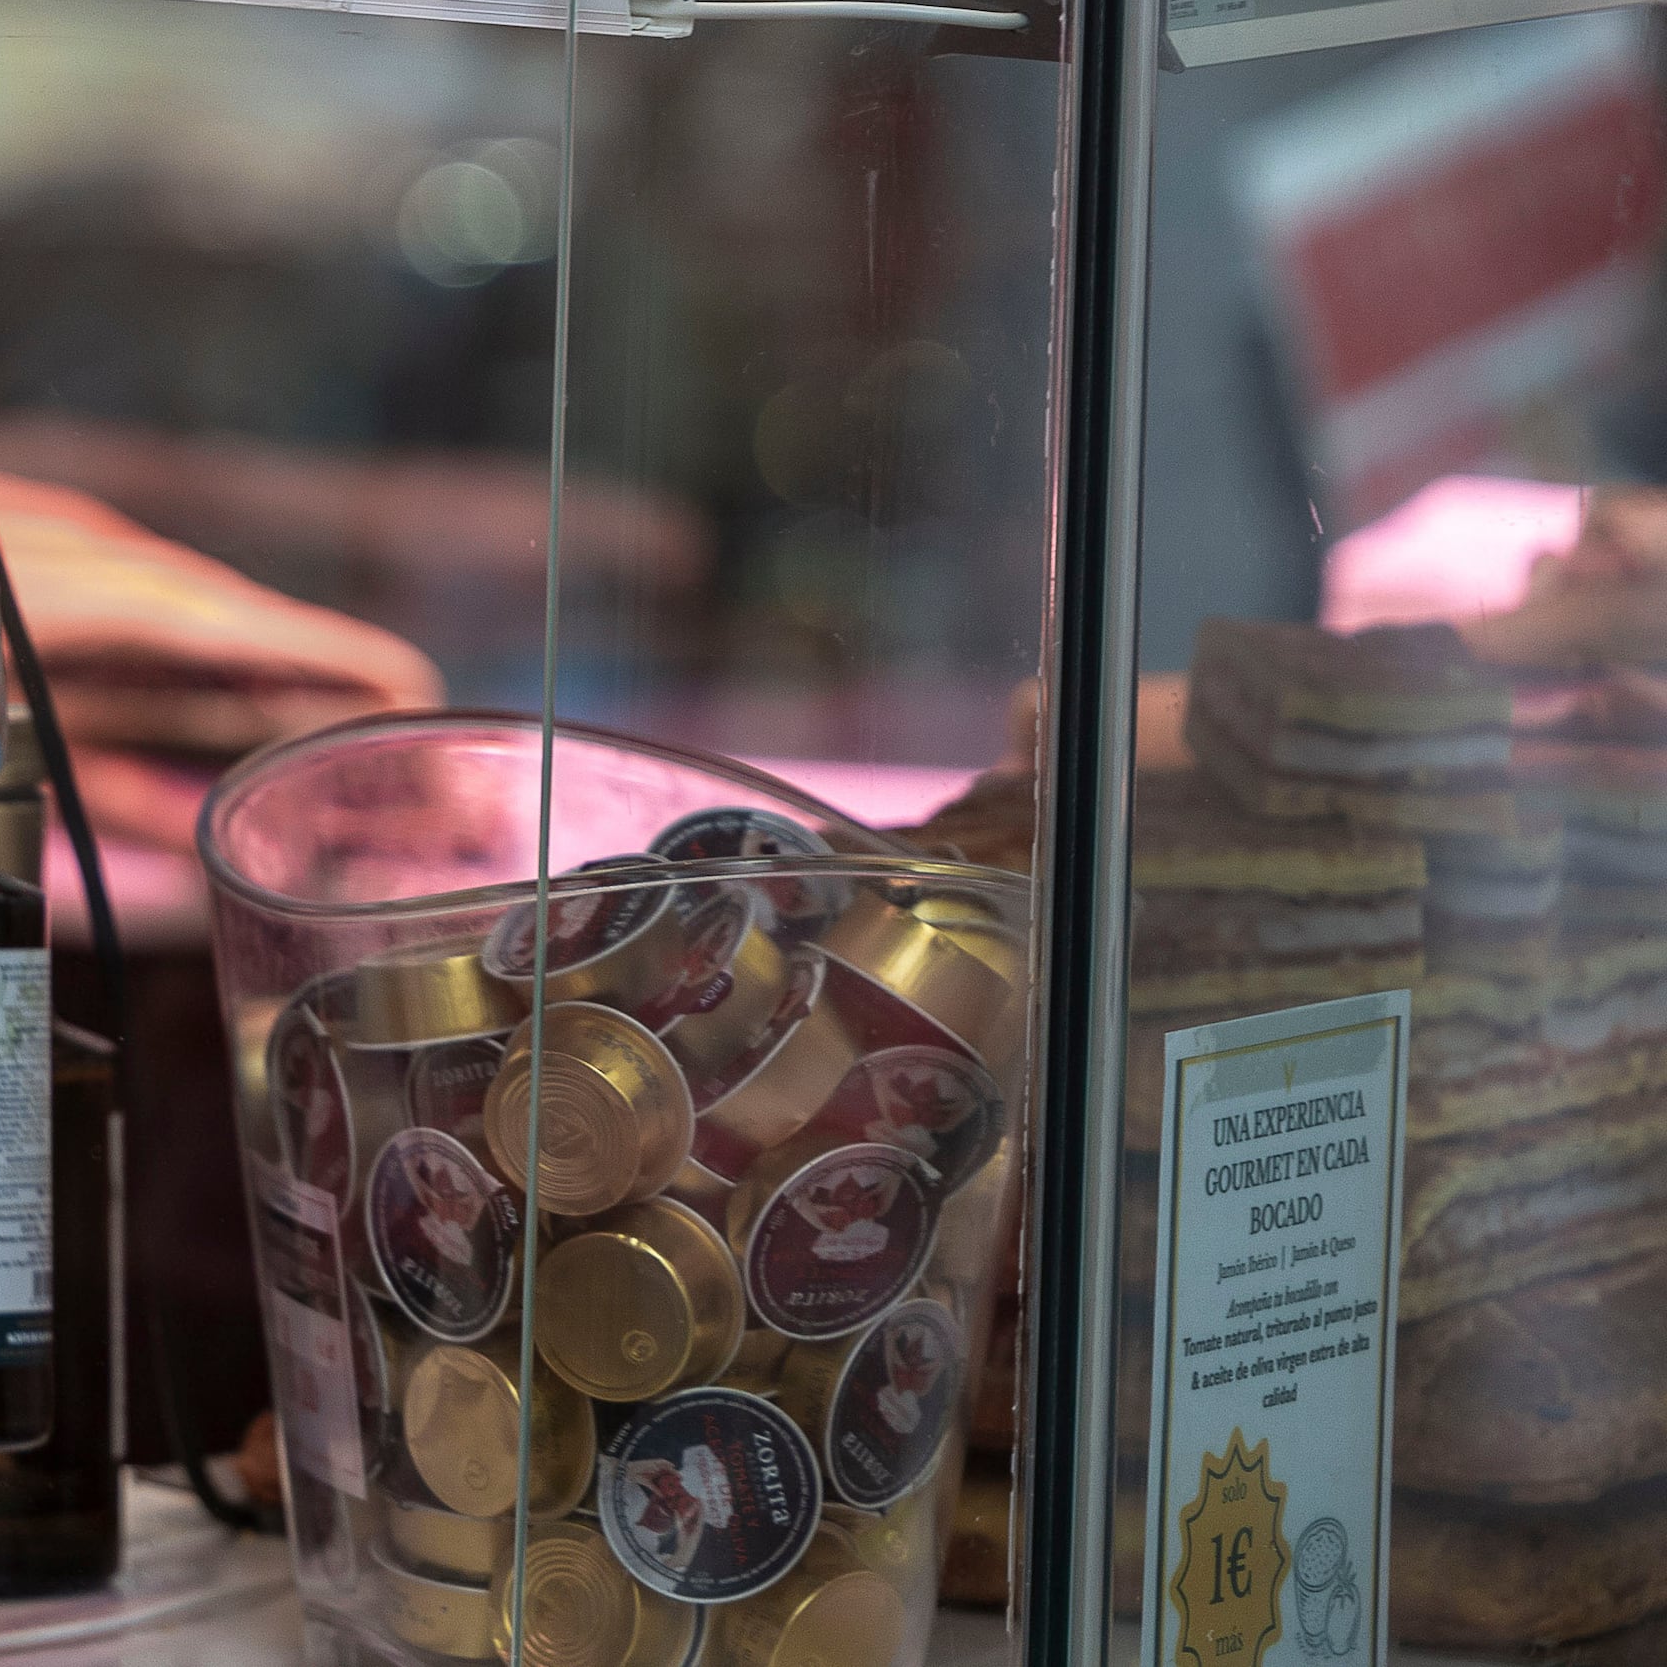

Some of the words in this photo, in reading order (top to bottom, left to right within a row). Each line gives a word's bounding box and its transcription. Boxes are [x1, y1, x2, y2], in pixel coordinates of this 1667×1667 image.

[1213, 1112, 1251, 1147] UNA
[1254, 1089, 1366, 1139] EXPERIENCIA
[1205, 1150, 1295, 1196] GOURMET
[1297, 1145, 1322, 1178] EN
[1323, 1136, 1370, 1171] CADA
[1249, 1193, 1323, 1236] BOCADO
[1217, 1258, 1247, 1284] Jamón
[1248, 1252, 1278, 1274] Ibérico
[1290, 1241, 1319, 1268] Jamón
[1320, 1239, 1328, 1256] &
[1329, 1236, 1356, 1257] Queso
[1226, 1292, 1273, 1319] Acompaña
[1273, 1292, 1283, 1308] tu
[1284, 1278, 1322, 1306] bocadillo
[1323, 1280, 1339, 1297] con
[1183, 1334, 1223, 1357] Tomate
[1224, 1322, 1265, 1348] natural,
[1265, 1311, 1312, 1338] triturado
[1313, 1307, 1323, 1327] al
[1323, 1305, 1353, 1331] punto
[1353, 1299, 1378, 1323] justo
[1191, 1370, 1200, 1391] &
[1202, 1365, 1234, 1388] aceite
[1235, 1360, 1249, 1381] de
[1250, 1356, 1275, 1377] oliva
[1275, 1351, 1308, 1374] virgen
[1308, 1345, 1336, 1363] extra
[1336, 1336, 1350, 1356] de
[1351, 1333, 1370, 1353] alta
[1262, 1383, 1298, 1408] calidad
[1221, 1477, 1248, 1504] solo
[1209, 1525, 1254, 1605] 1€
[1215, 1625, 1244, 1656] más
